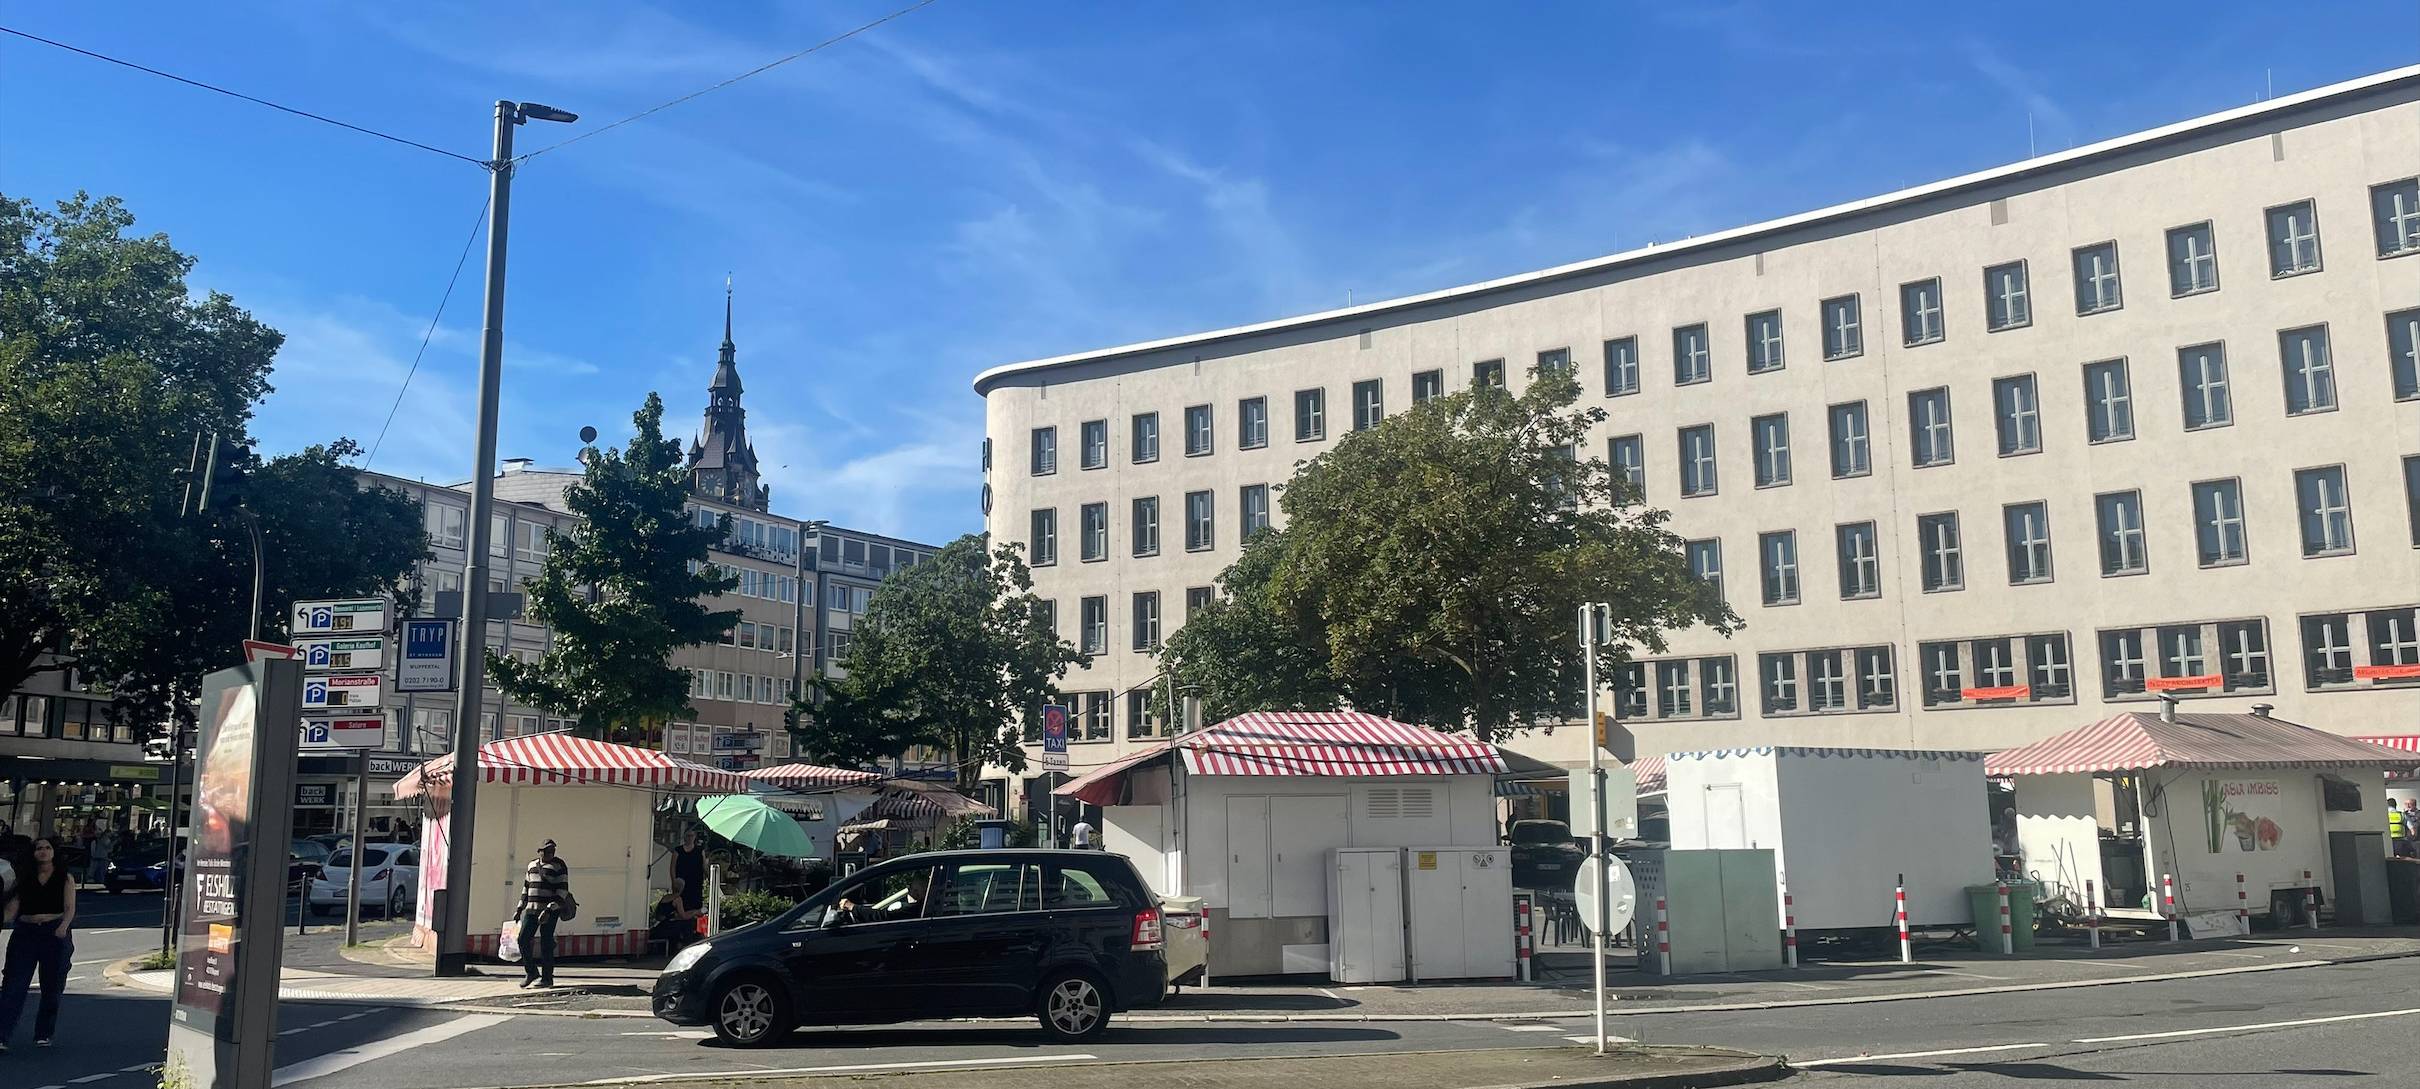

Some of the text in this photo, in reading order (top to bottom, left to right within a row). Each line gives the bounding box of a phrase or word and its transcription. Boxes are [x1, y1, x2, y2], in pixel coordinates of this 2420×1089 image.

[411, 627, 444, 642] TRYP
[336, 640, 377, 650] Galeria Kaufhof
[331, 678, 376, 686] Morianstraße
[1046, 738, 1065, 748] TAXI
[301, 786, 326, 796] back
